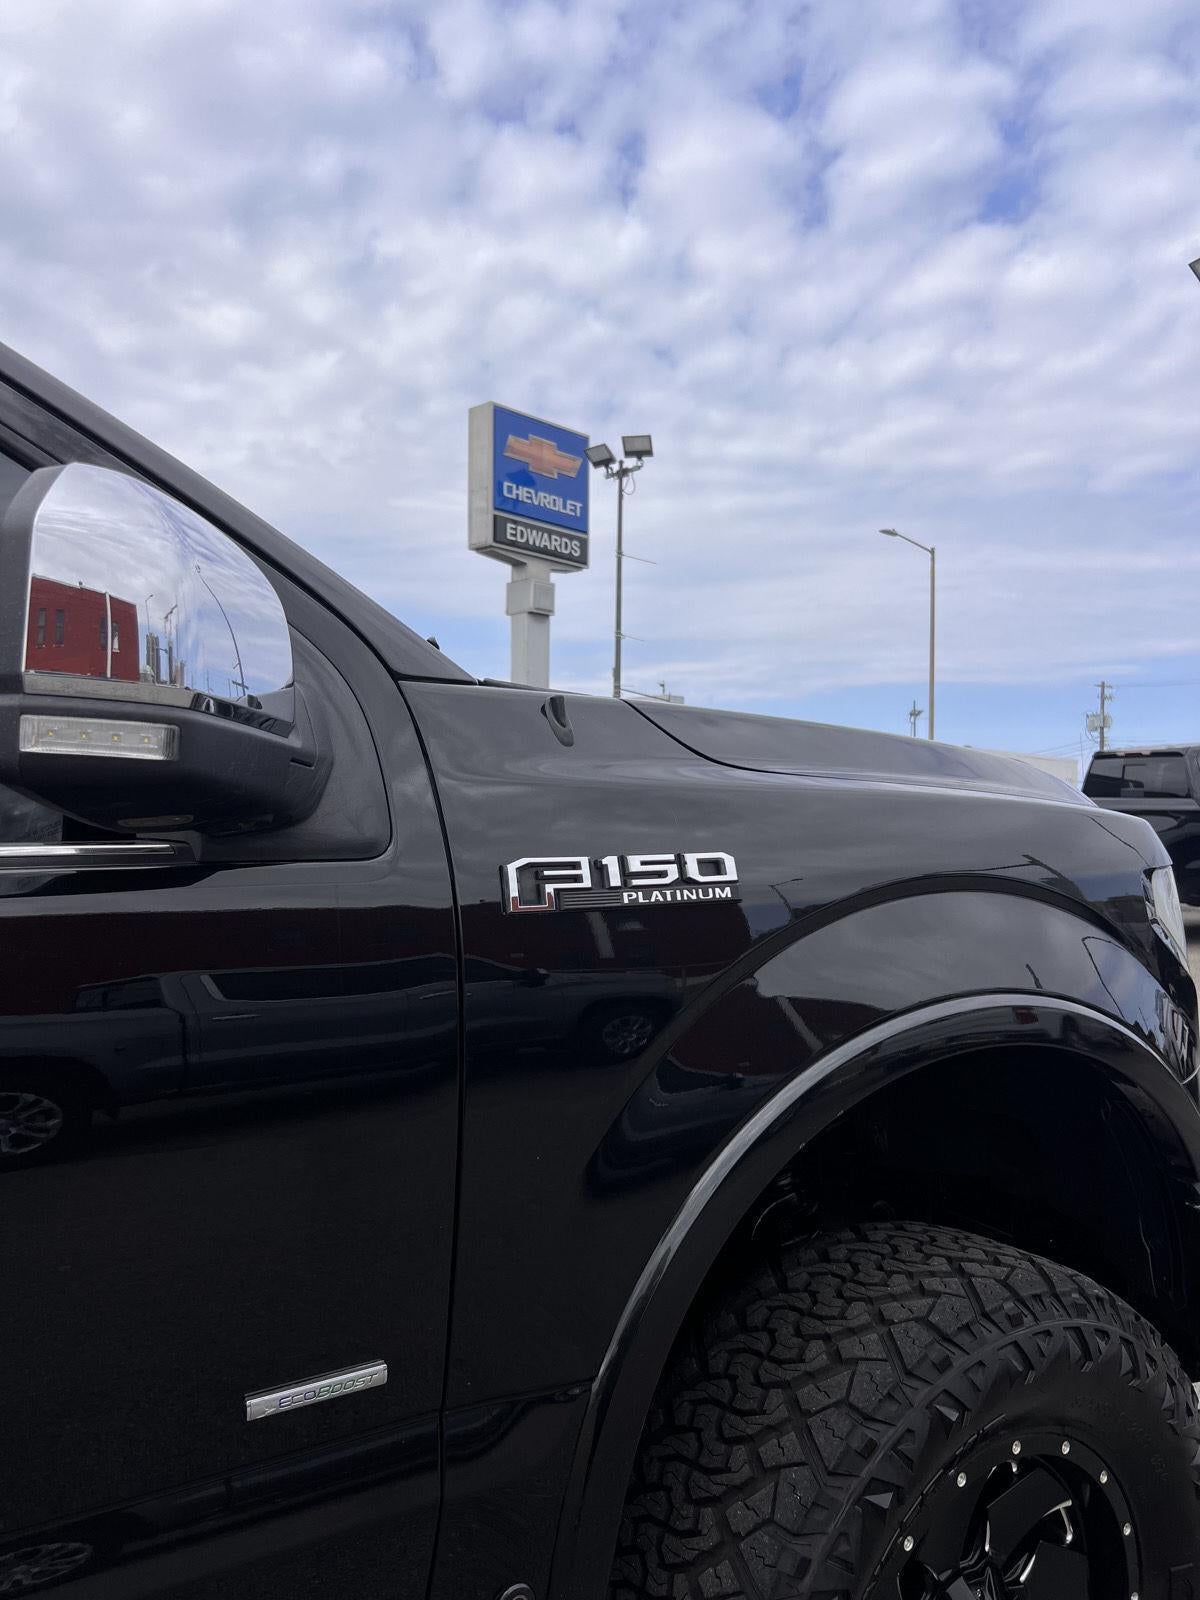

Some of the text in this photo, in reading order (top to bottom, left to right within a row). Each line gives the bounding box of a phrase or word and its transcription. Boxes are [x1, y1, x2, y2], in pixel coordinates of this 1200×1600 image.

[503, 481, 583, 517] CHEVROLET
[506, 523, 581, 557] EDWARDS
[622, 886, 732, 904] PLATINUM
